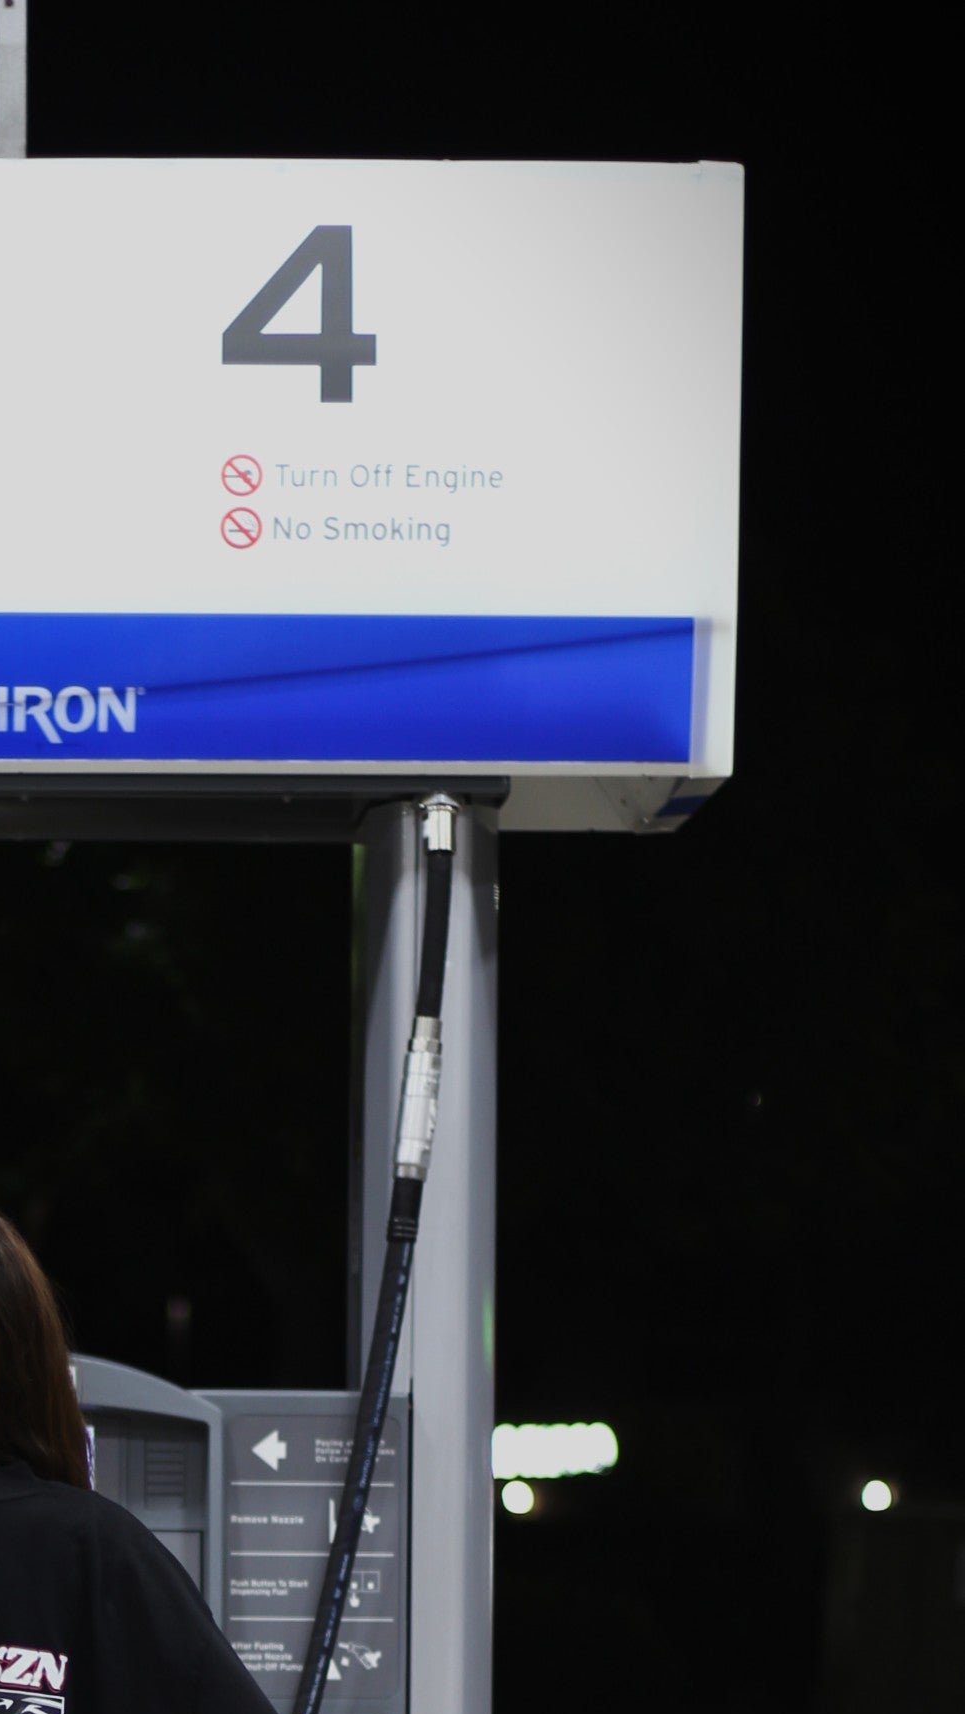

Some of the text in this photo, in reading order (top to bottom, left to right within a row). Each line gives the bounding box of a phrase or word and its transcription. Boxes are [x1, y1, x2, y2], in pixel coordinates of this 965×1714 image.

[222, 225, 376, 403] 4
[275, 464, 503, 494] Turn Off Engine
[273, 517, 451, 547] No Smoking
[230, 1515, 304, 1524] Remove Nozzle
